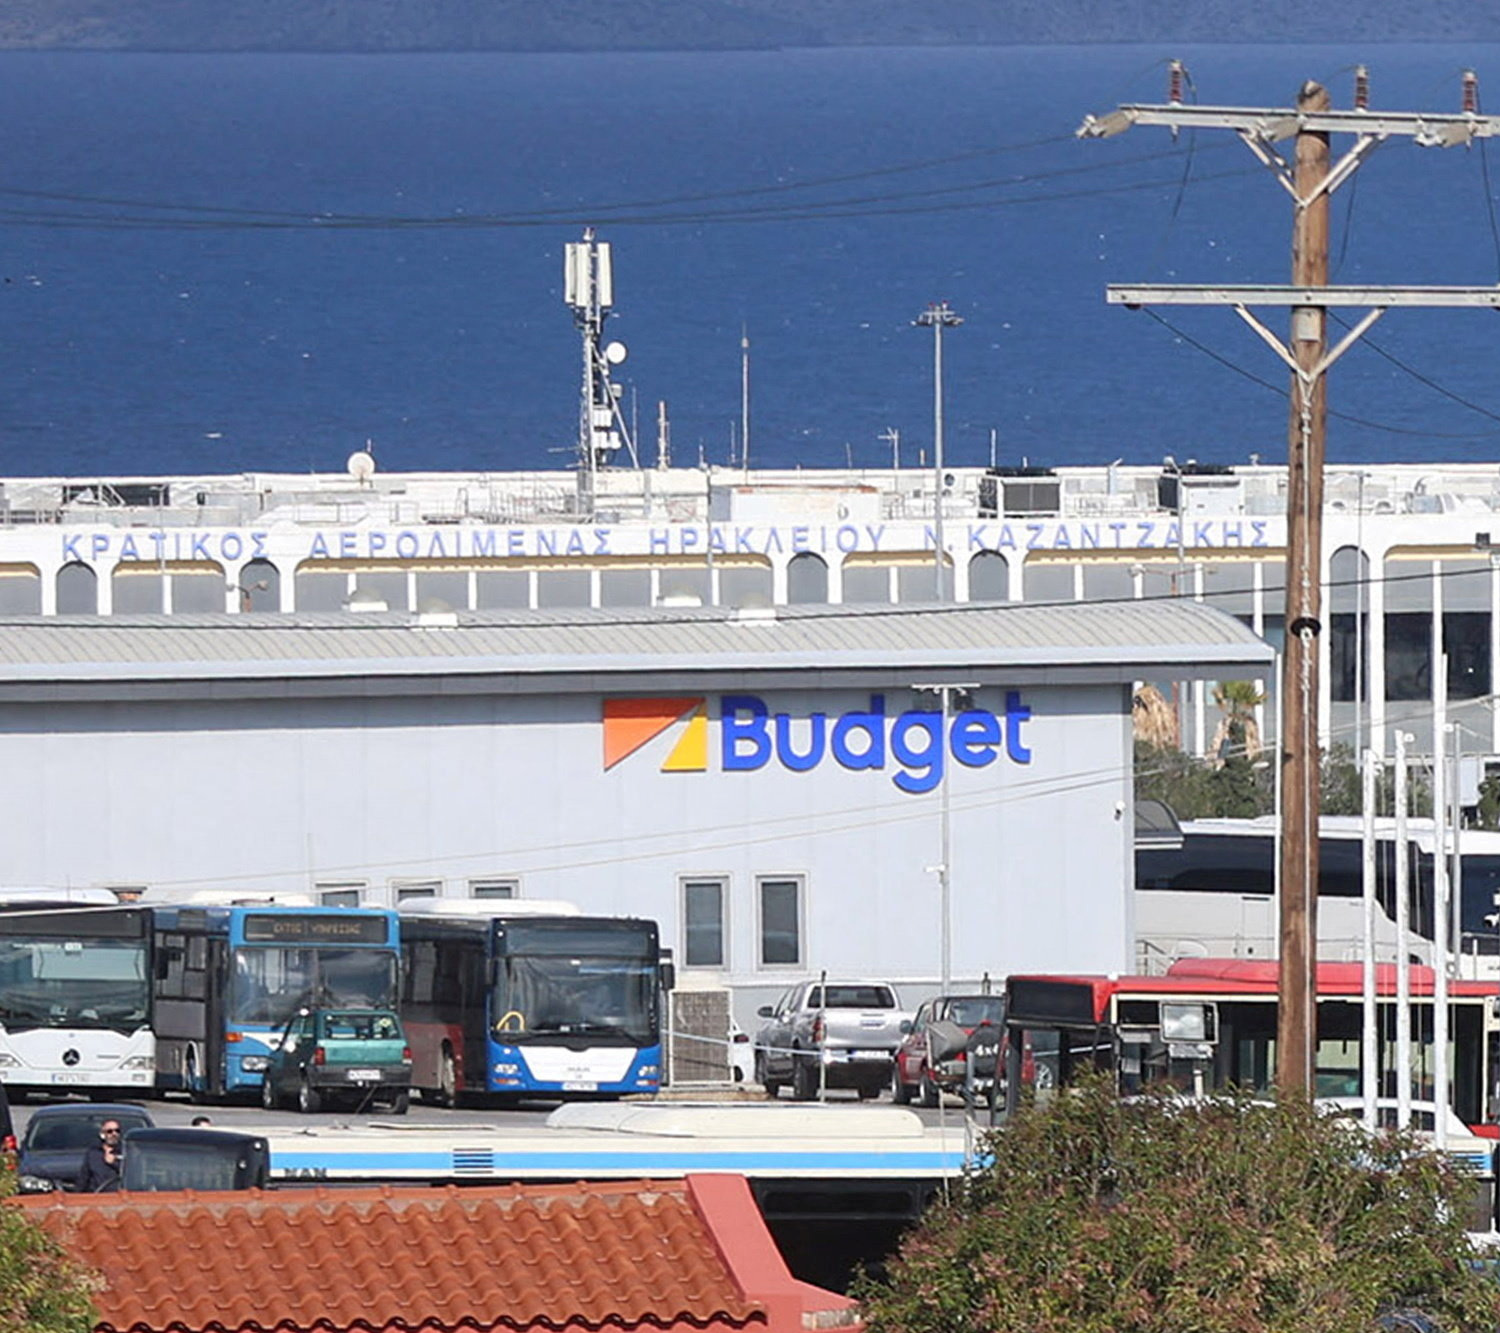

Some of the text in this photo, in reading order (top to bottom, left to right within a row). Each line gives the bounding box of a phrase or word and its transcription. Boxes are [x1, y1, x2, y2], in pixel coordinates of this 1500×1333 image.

[62, 532, 269, 561] ΚΡΑΤΙΚΟΣ
[310, 529, 612, 558] ΑΕΡΟΛΙΜΕΝΑΣ
[650, 523, 885, 554] ΗΡΑΚΛΕΙΟΥ
[720, 690, 1032, 794] Budget
